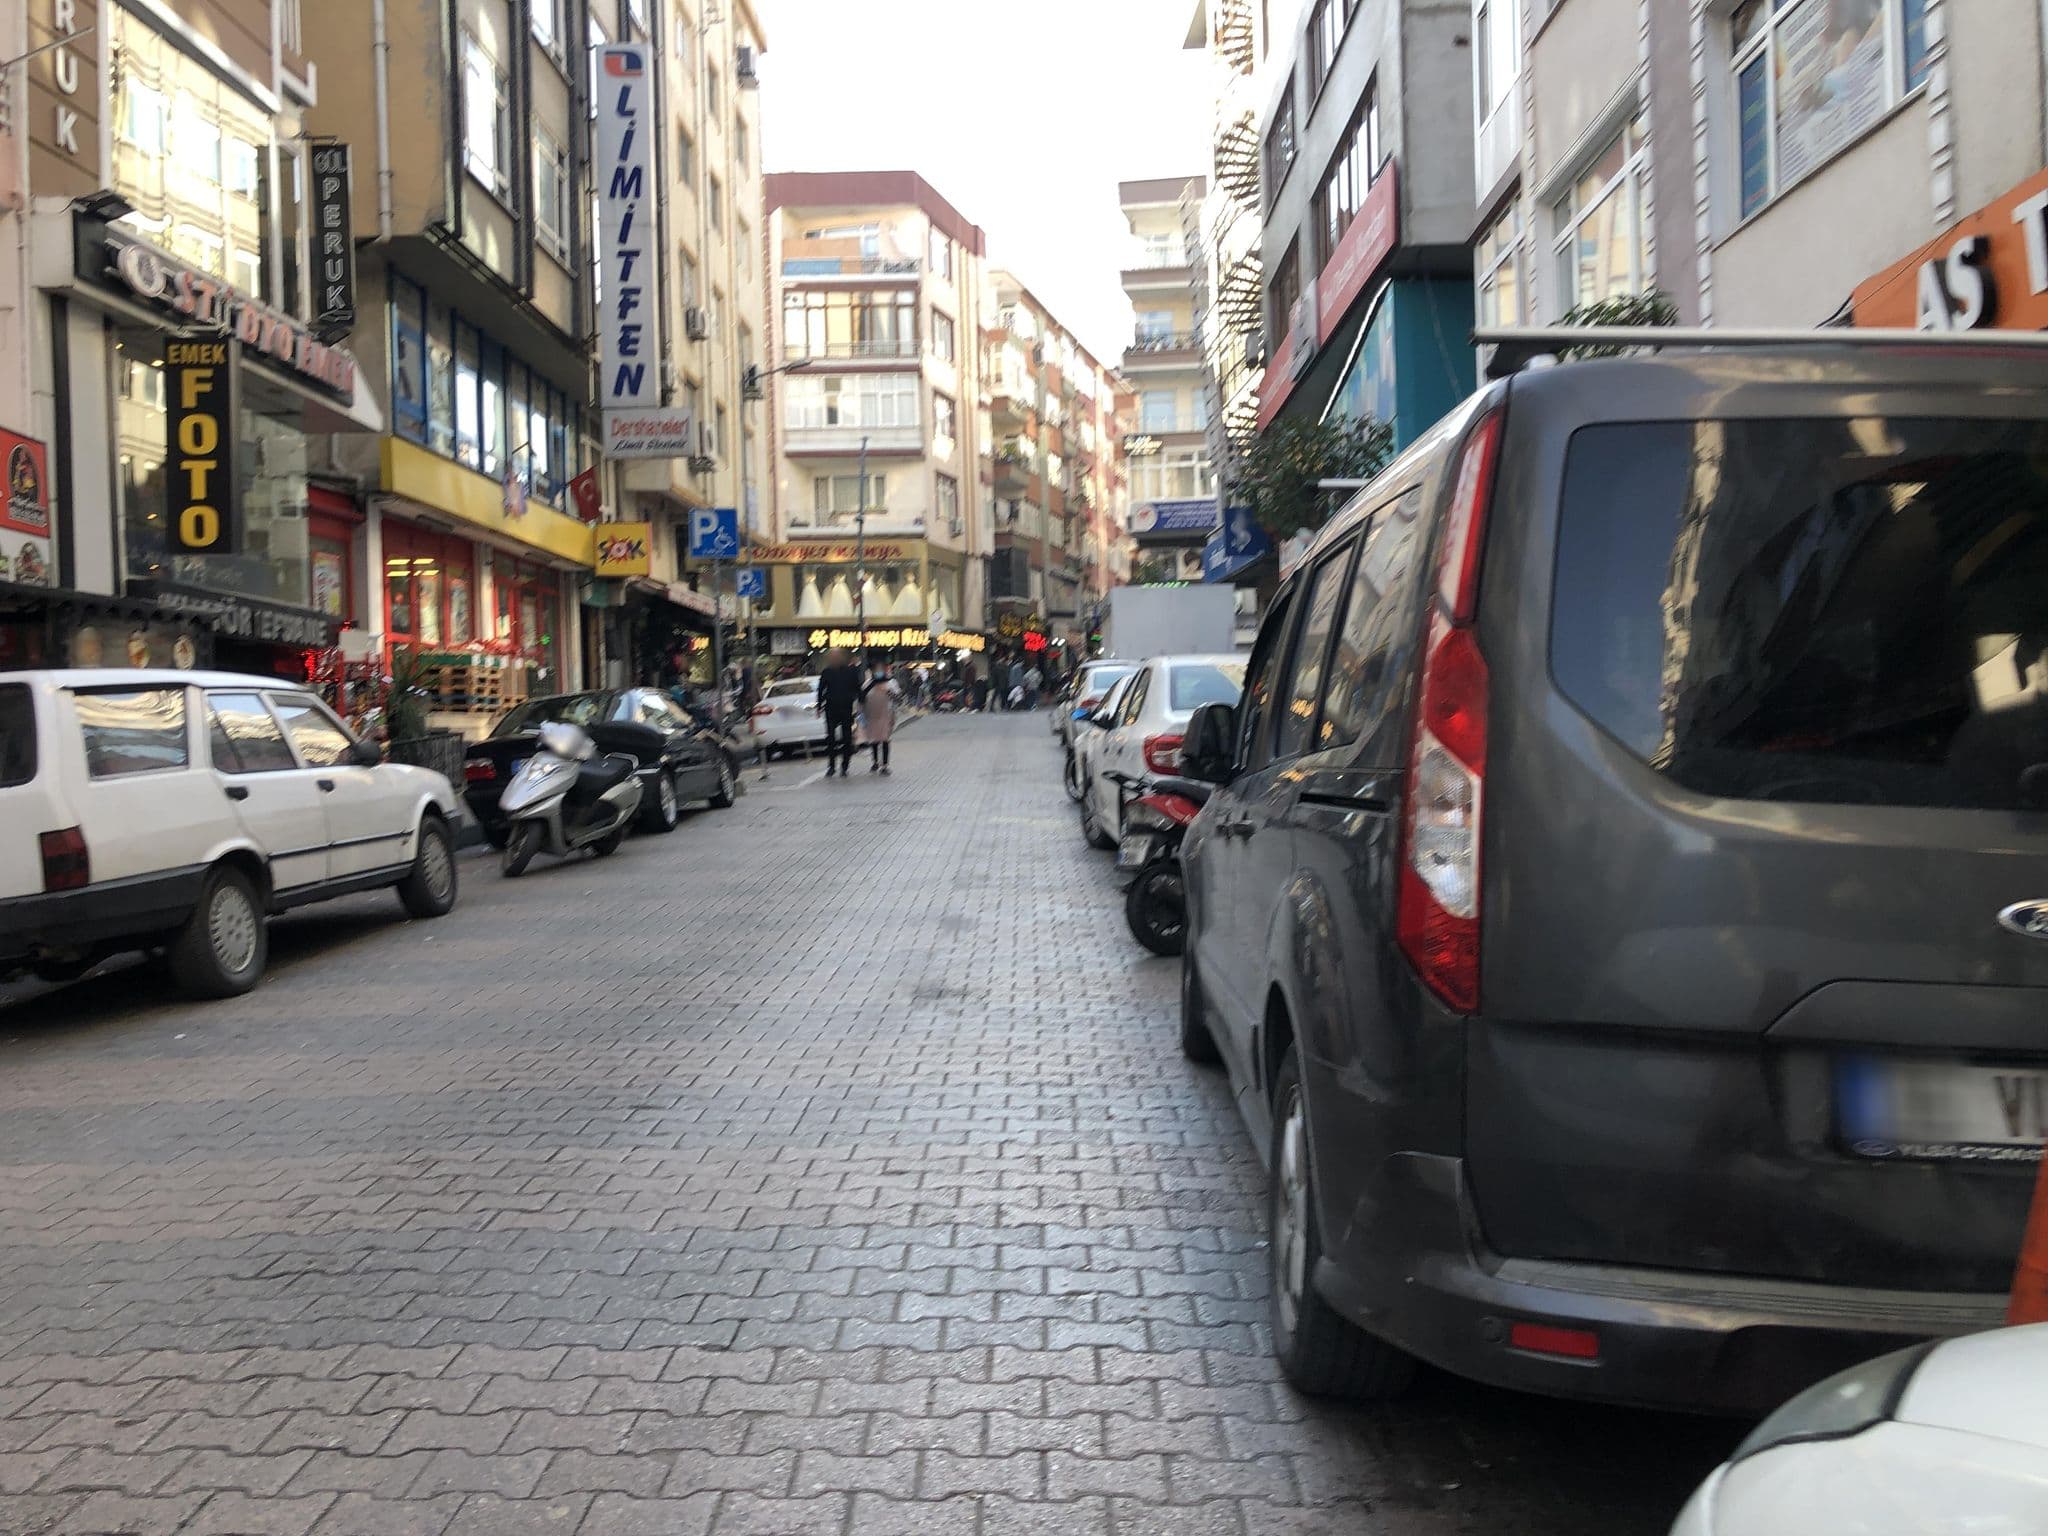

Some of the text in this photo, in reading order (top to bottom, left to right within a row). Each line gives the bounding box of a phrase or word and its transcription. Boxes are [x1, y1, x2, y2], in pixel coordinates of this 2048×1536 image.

[322, 176, 346, 309] PERUK
[167, 344, 226, 365] EMEK
[178, 368, 220, 548] FOTO
[693, 510, 719, 548] P
